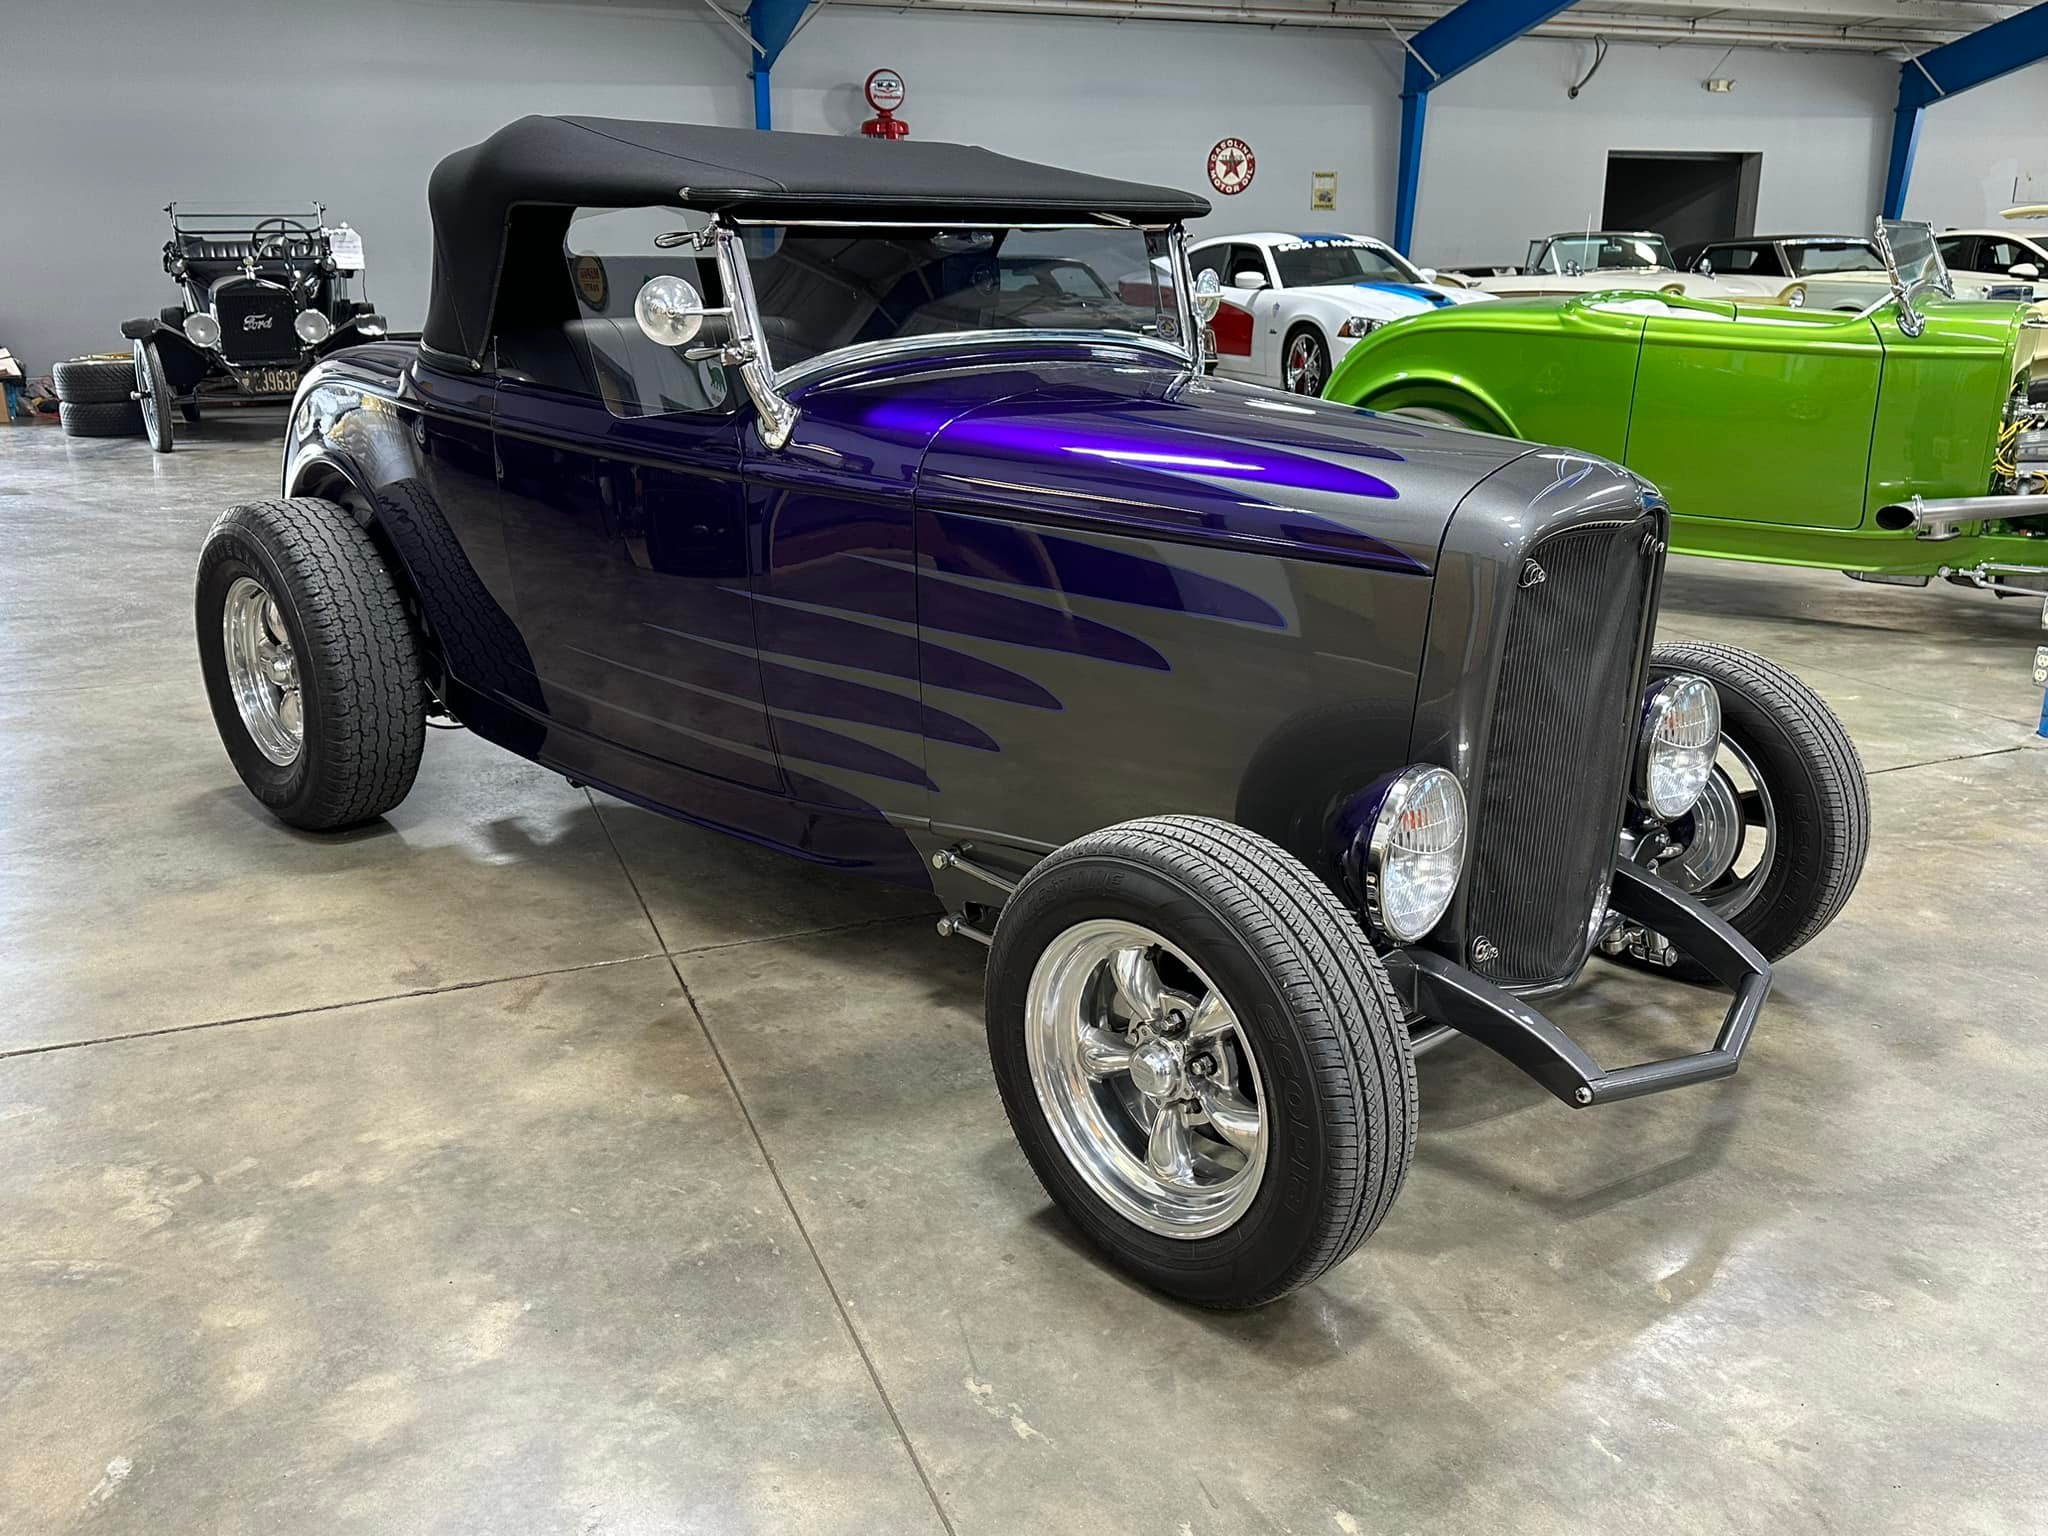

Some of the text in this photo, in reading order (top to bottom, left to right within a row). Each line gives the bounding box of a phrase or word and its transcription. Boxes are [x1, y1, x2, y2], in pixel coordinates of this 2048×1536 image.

[1211, 140, 1253, 162] GASOLINE
[1210, 169, 1240, 193] MOTOR
[1242, 167, 1254, 186] OIL
[1278, 241, 1312, 252] SOX
[243, 314, 273, 331] Ford
